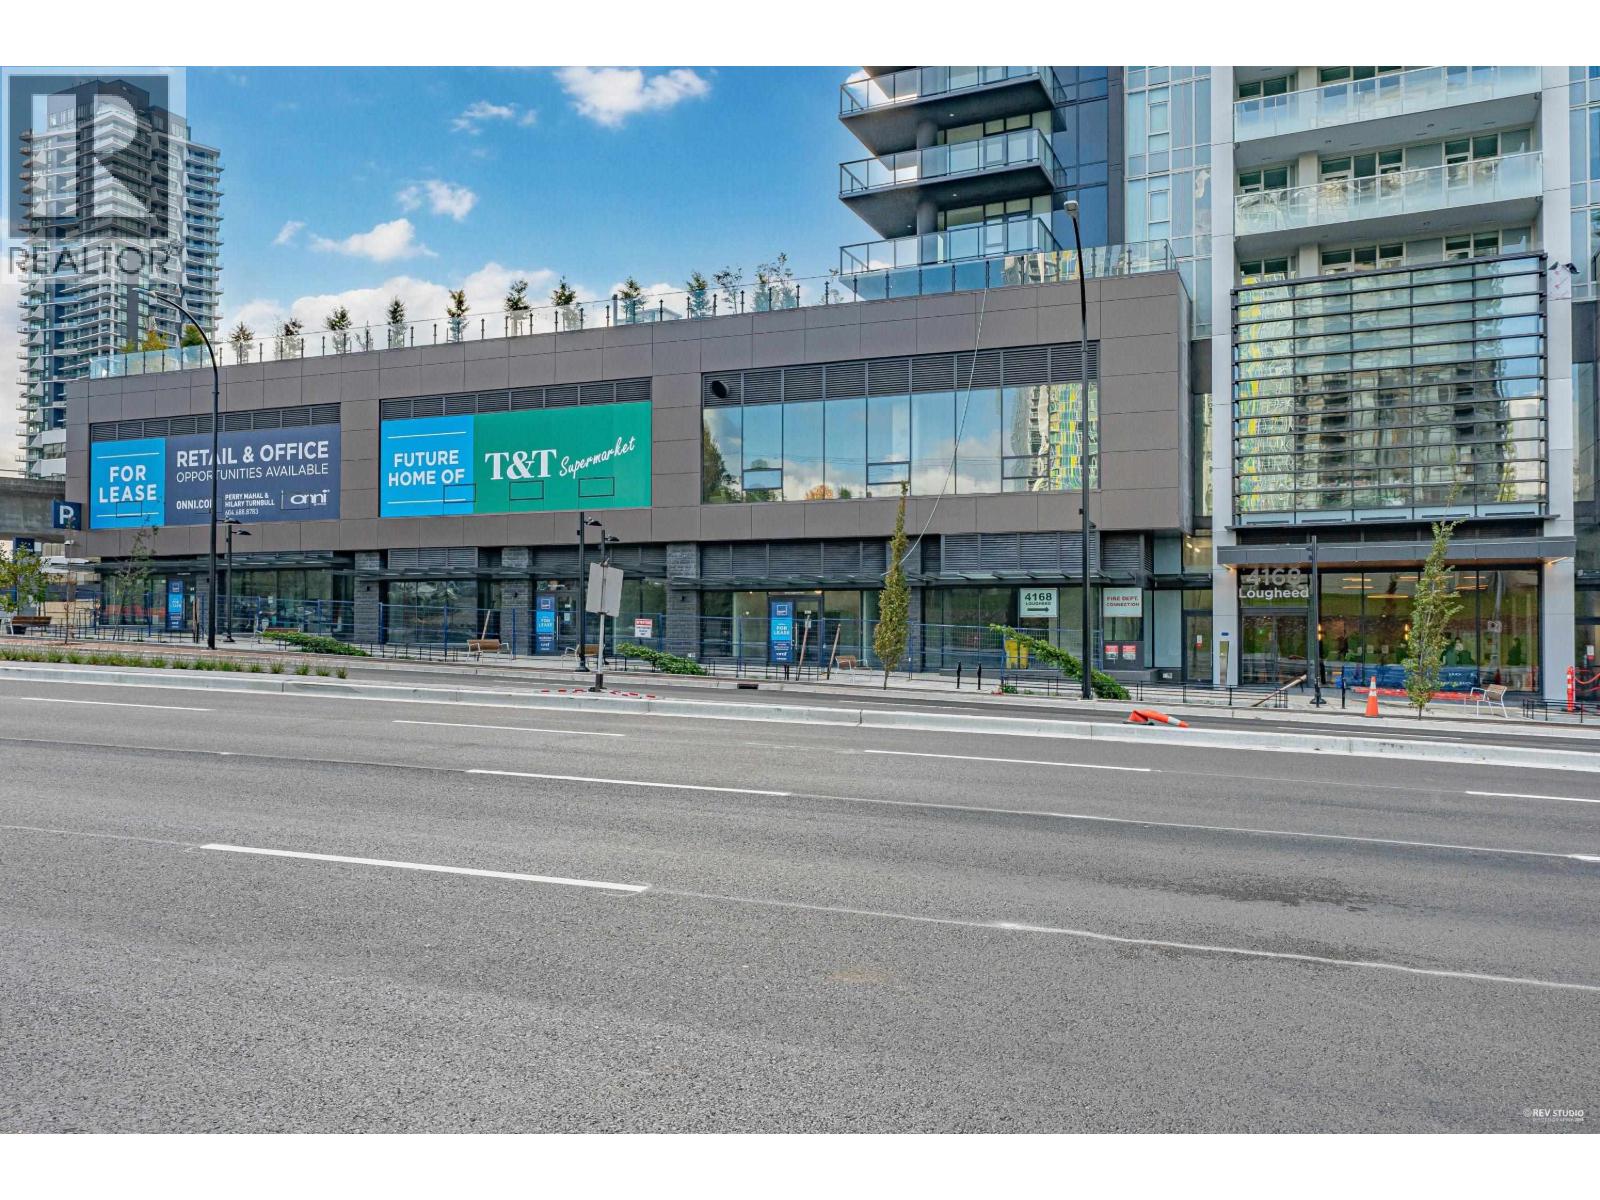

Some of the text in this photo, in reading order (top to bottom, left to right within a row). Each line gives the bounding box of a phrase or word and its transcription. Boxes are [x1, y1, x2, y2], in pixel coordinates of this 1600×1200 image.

[176, 440, 329, 468] RETAIL & OFFICE
[394, 449, 459, 468] FUTURE
[484, 435, 636, 481] T&T Supermarket
[109, 464, 147, 483] FOR
[176, 462, 329, 483] OPPORTUNITIES AVAILABLE
[388, 468, 465, 487] HOME OF
[99, 483, 158, 503] LEASE
[224, 493, 243, 501] PERRY
[243, 492, 264, 500] MAHAL
[176, 499, 213, 510] ONNI.CO
[224, 498, 275, 508] HILARY TURNBULL
[59, 504, 75, 525] P
[1246, 567, 1301, 586] 4168
[1024, 592, 1053, 601] 4168
[1239, 587, 1309, 600] Lougheed
